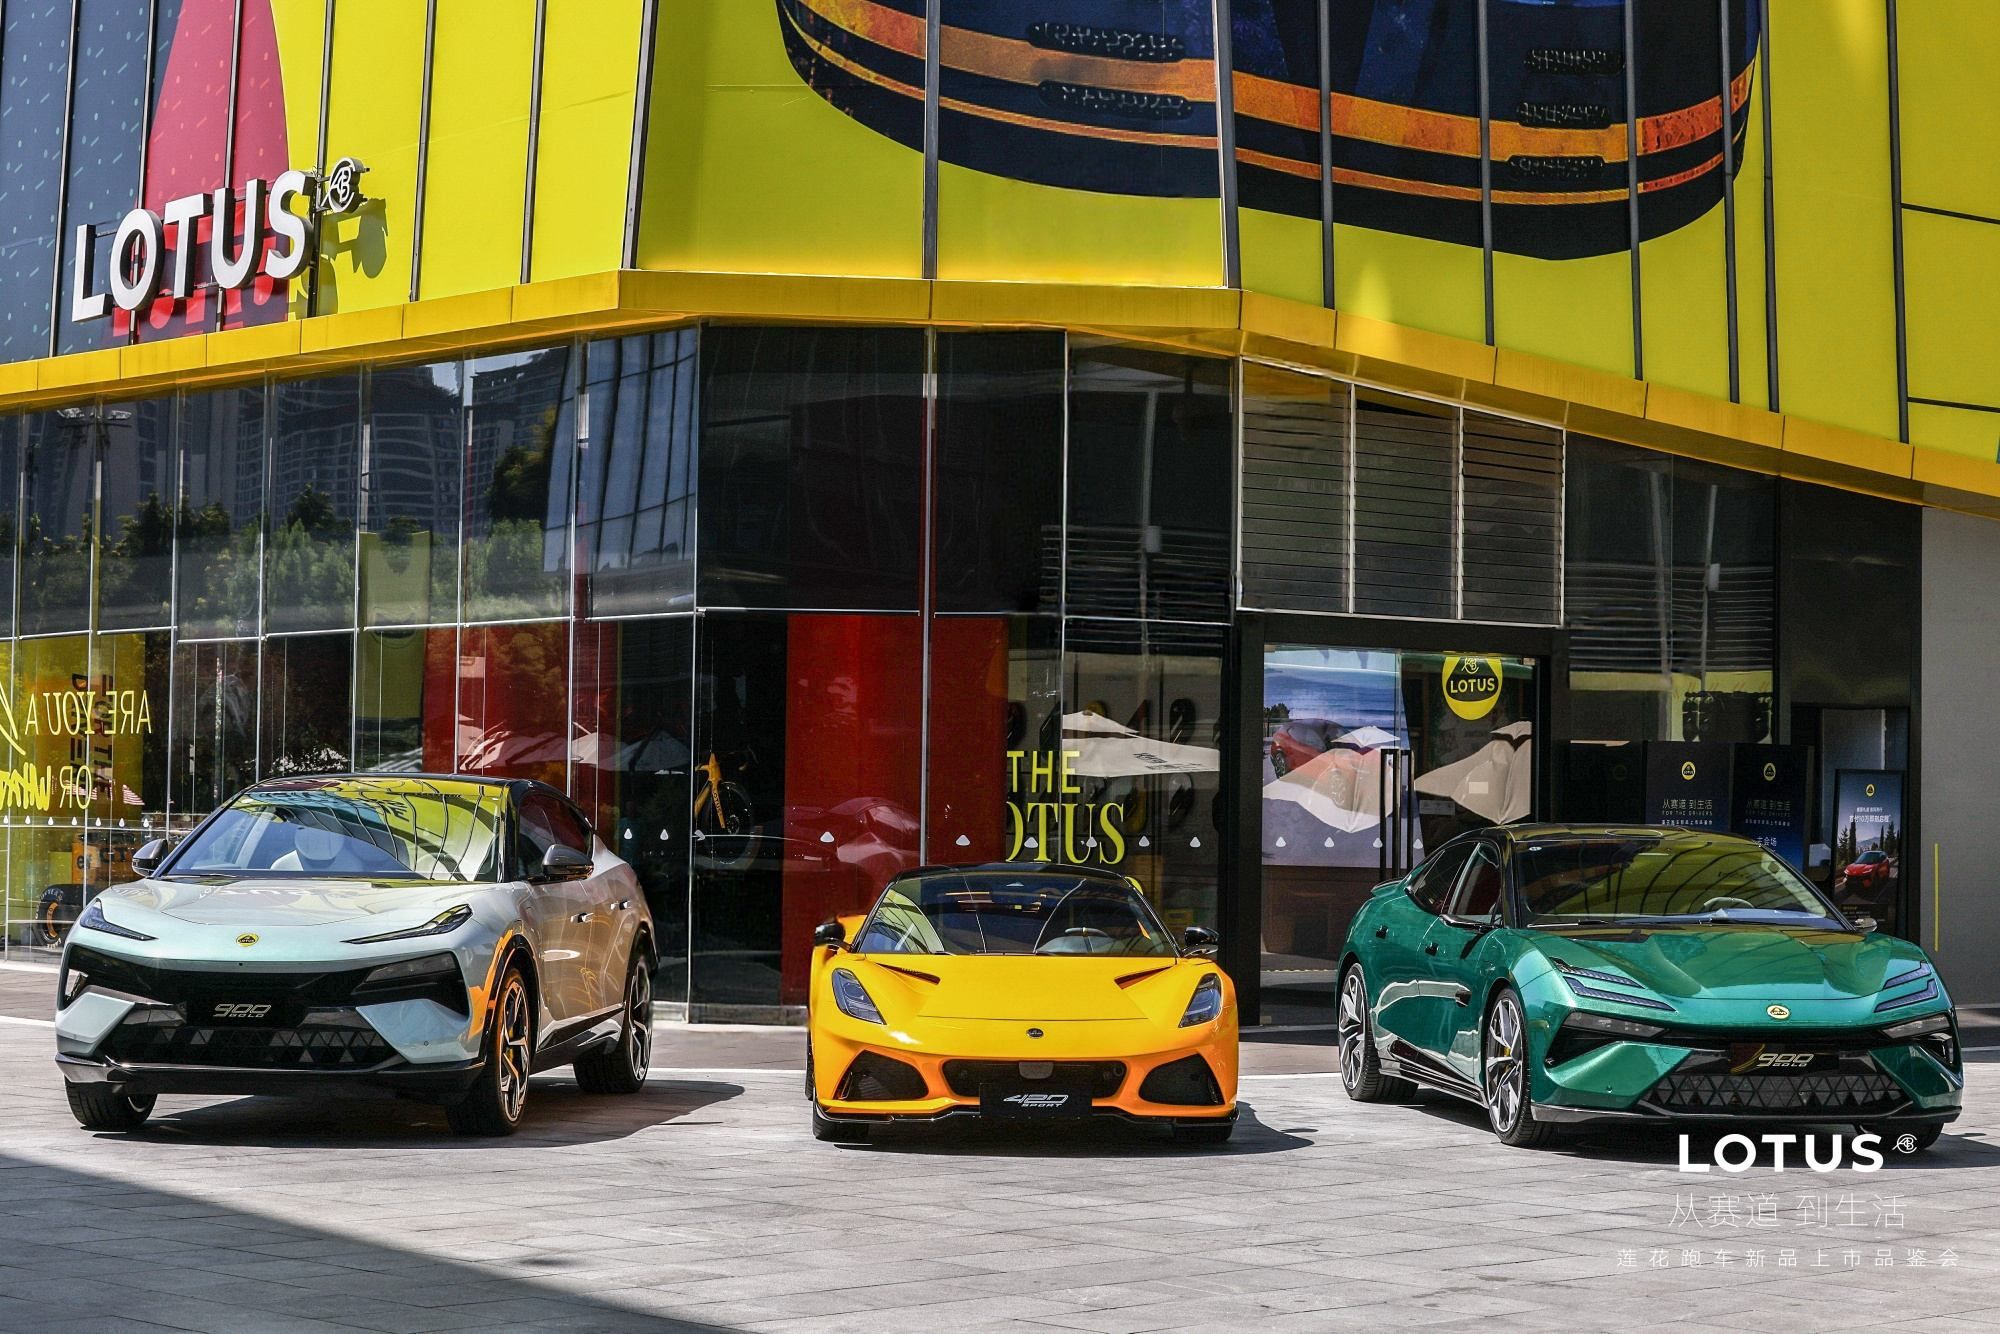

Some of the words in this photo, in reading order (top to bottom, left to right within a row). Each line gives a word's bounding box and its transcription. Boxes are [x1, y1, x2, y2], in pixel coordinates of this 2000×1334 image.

[72, 170, 313, 322] LOTUS
[1450, 677, 1495, 693] LOTUS
[1006, 750, 1081, 793] THE
[213, 1003, 272, 1017] 900
[1757, 1053, 1815, 1067] 900
[1003, 1093, 1069, 1104] 420
